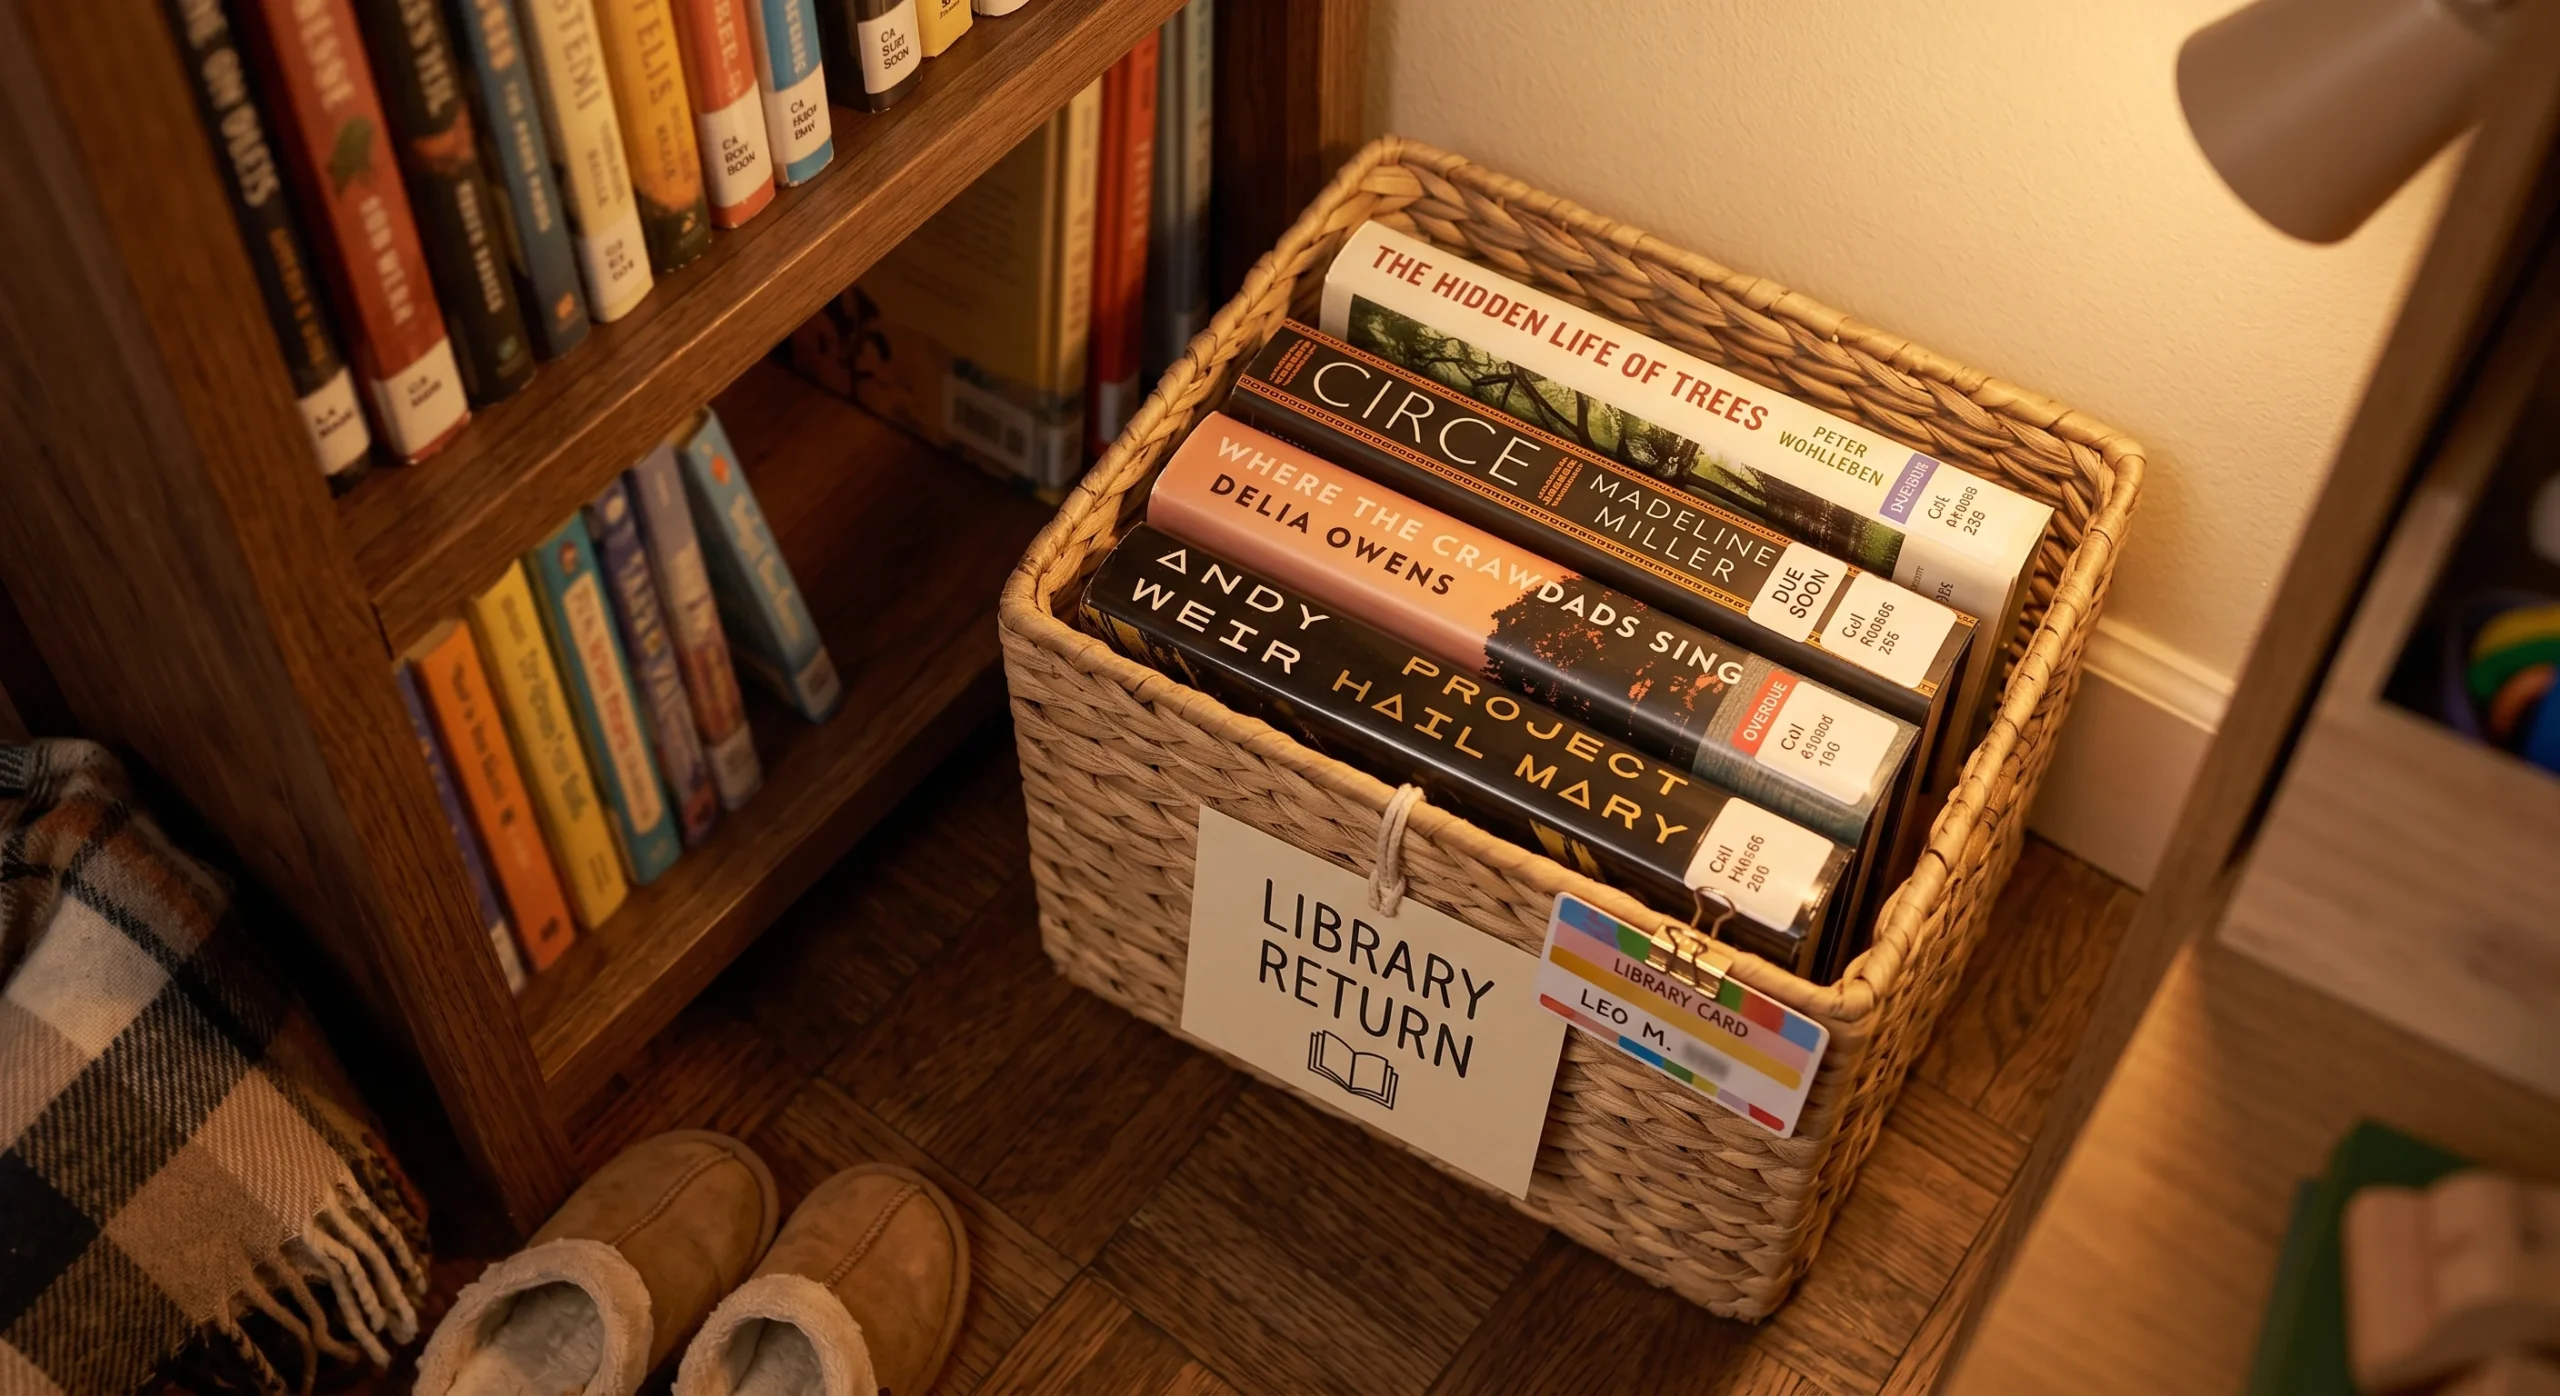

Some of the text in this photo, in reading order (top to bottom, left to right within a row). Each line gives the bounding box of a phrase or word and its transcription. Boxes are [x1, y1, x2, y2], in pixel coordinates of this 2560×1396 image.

[884, 47, 909, 70] SOON
[1372, 244, 1769, 431] THE HIDDEN LIFE OF TREES
[1313, 361, 1541, 486] CIRCE
[1778, 430, 1885, 487] WOHLLEBEN
[1812, 425, 1868, 459] PETER
[1210, 473, 1455, 595] DELIA OWENS
[1218, 436, 1744, 686] WHERE THE CRAWDADS SING
[1589, 473, 1776, 567] MADELINE
[1593, 506, 1735, 583] MILLER
[1131, 577, 1301, 675] WEIR
[1155, 548, 1330, 631] ANDY
[1771, 566, 1805, 604] DUE
[1789, 568, 1830, 619] SOON
[1402, 656, 1689, 796] PROJECT
[1743, 681, 1789, 741] OVERDUE
[1331, 669, 1689, 845] HAIL MARY
[1263, 878, 1495, 1020] LIBRARY
[1259, 939, 1473, 1078] RETURN
[1580, 988, 1672, 1051] LEO M.
[1614, 957, 1749, 1038] LIBRARY CARD
